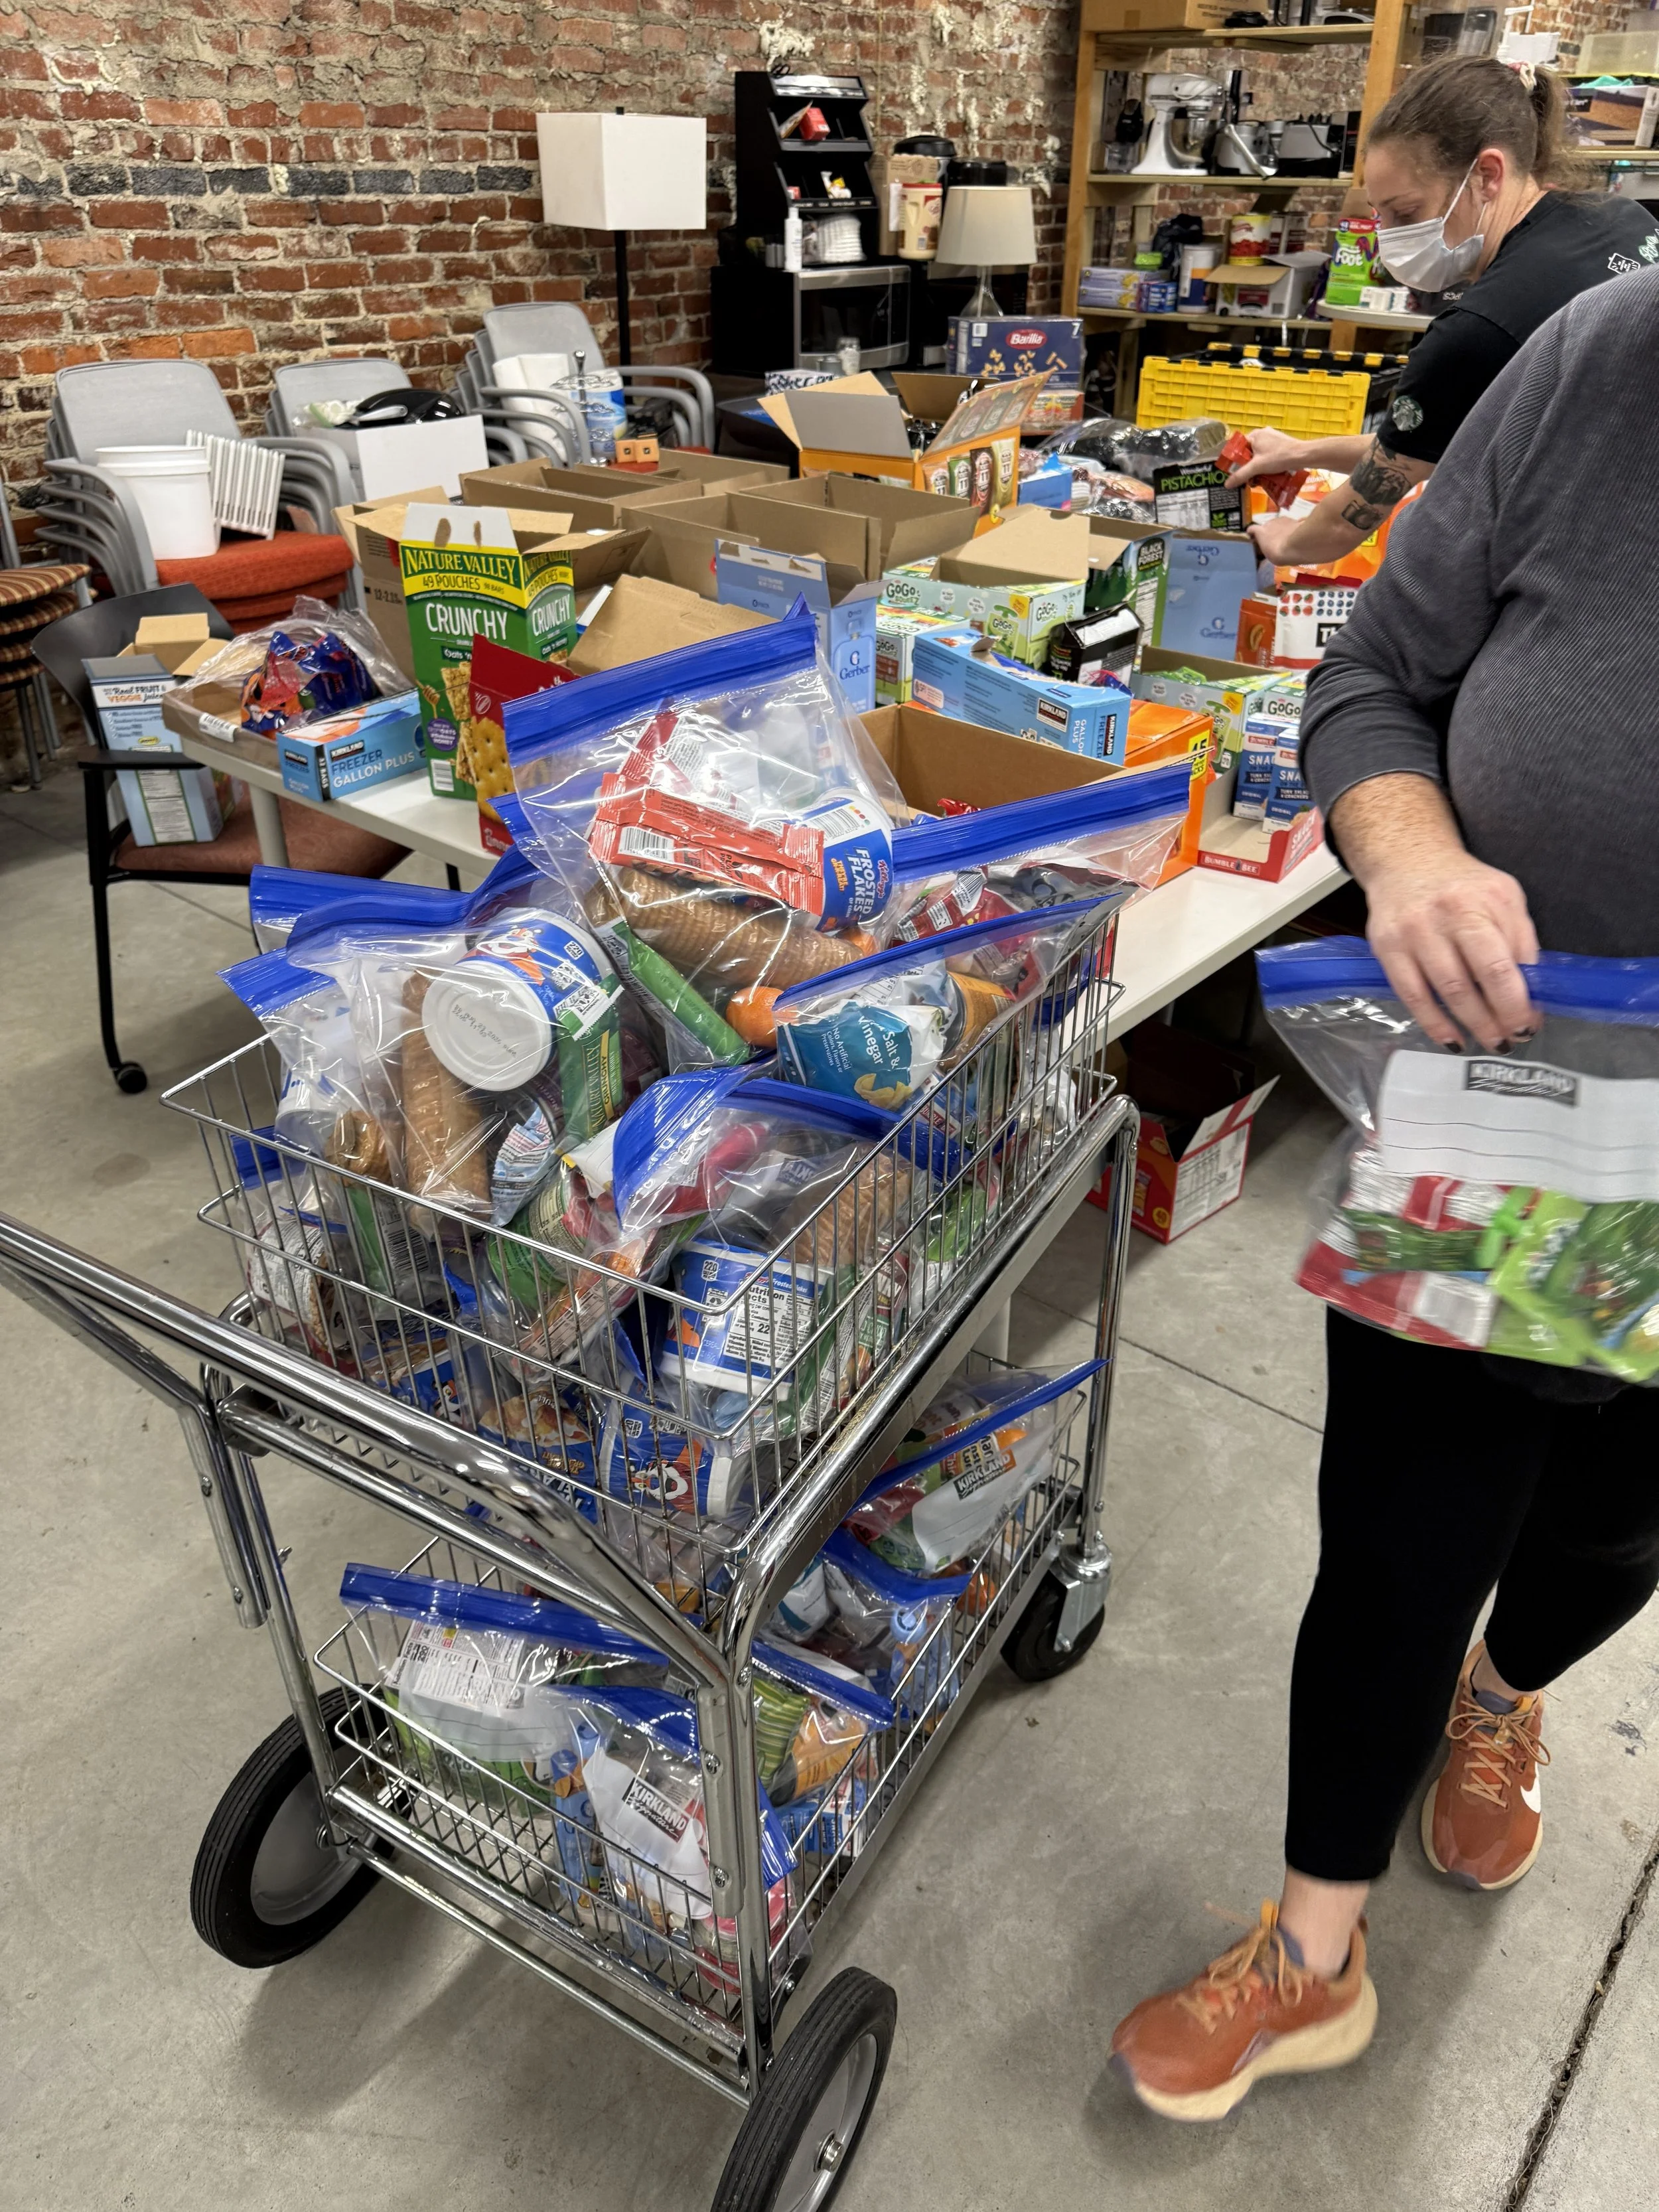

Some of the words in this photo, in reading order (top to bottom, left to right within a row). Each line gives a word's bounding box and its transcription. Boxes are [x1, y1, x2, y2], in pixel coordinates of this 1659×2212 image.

[1334, 247, 1363, 266] Foot
[1010, 333, 1044, 345] Barilla
[1071, 322, 1081, 336] 7
[1161, 470, 1228, 492] PISTACHIO
[1138, 553, 1163, 565] FOREST
[1141, 541, 1163, 555] BLACK
[404, 549, 464, 575] NATURE
[463, 554, 516, 585] VALLEY
[423, 576, 435, 588] 49
[436, 573, 480, 590] POUCHES
[425, 603, 508, 640] CRUNCHY
[532, 593, 571, 637] CRUNCHY
[444, 648, 463, 659] Oats
[839, 664, 871, 680] Gerber
[1040, 701, 1067, 719] KIRKLAND
[1268, 701, 1301, 715] GoGo
[1096, 715, 1106, 759] FREEZER
[1106, 715, 1116, 755] KIRKLAND
[331, 749, 383, 775] FREEZER
[333, 765, 382, 788] GALLON
[386, 751, 415, 770] PLUS
[1279, 771, 1301, 781] SNA
[1204, 856, 1235, 869] BUMBLE
[1241, 864, 1257, 873] BEE
[847, 856, 865, 913] FLAKES
[855, 848, 876, 915] FROSTED
[877, 859, 889, 899] Kellogg's
[569, 942, 583, 956] 220
[832, 1027, 840, 1040] No
[857, 1015, 884, 1065] Vinegar
[883, 1031, 899, 1057] Salt
[821, 1033, 834, 1067] Preservatives
[832, 1049, 841, 1068] Flavors
[835, 1040, 852, 1070] Artificial
[587, 1044, 601, 1086] VALLEY
[890, 1057, 901, 1070] &
[601, 1056, 609, 1105] CRUNCHY
[589, 1088, 606, 1130] NATURE
[705, 1260, 718, 1272] 220
[757, 1323, 770, 1335] 22
[957, 1453, 1011, 1491] KIRKLAND
[626, 1797, 680, 1838] Signature
[630, 1782, 687, 1832] KIRKLAND
